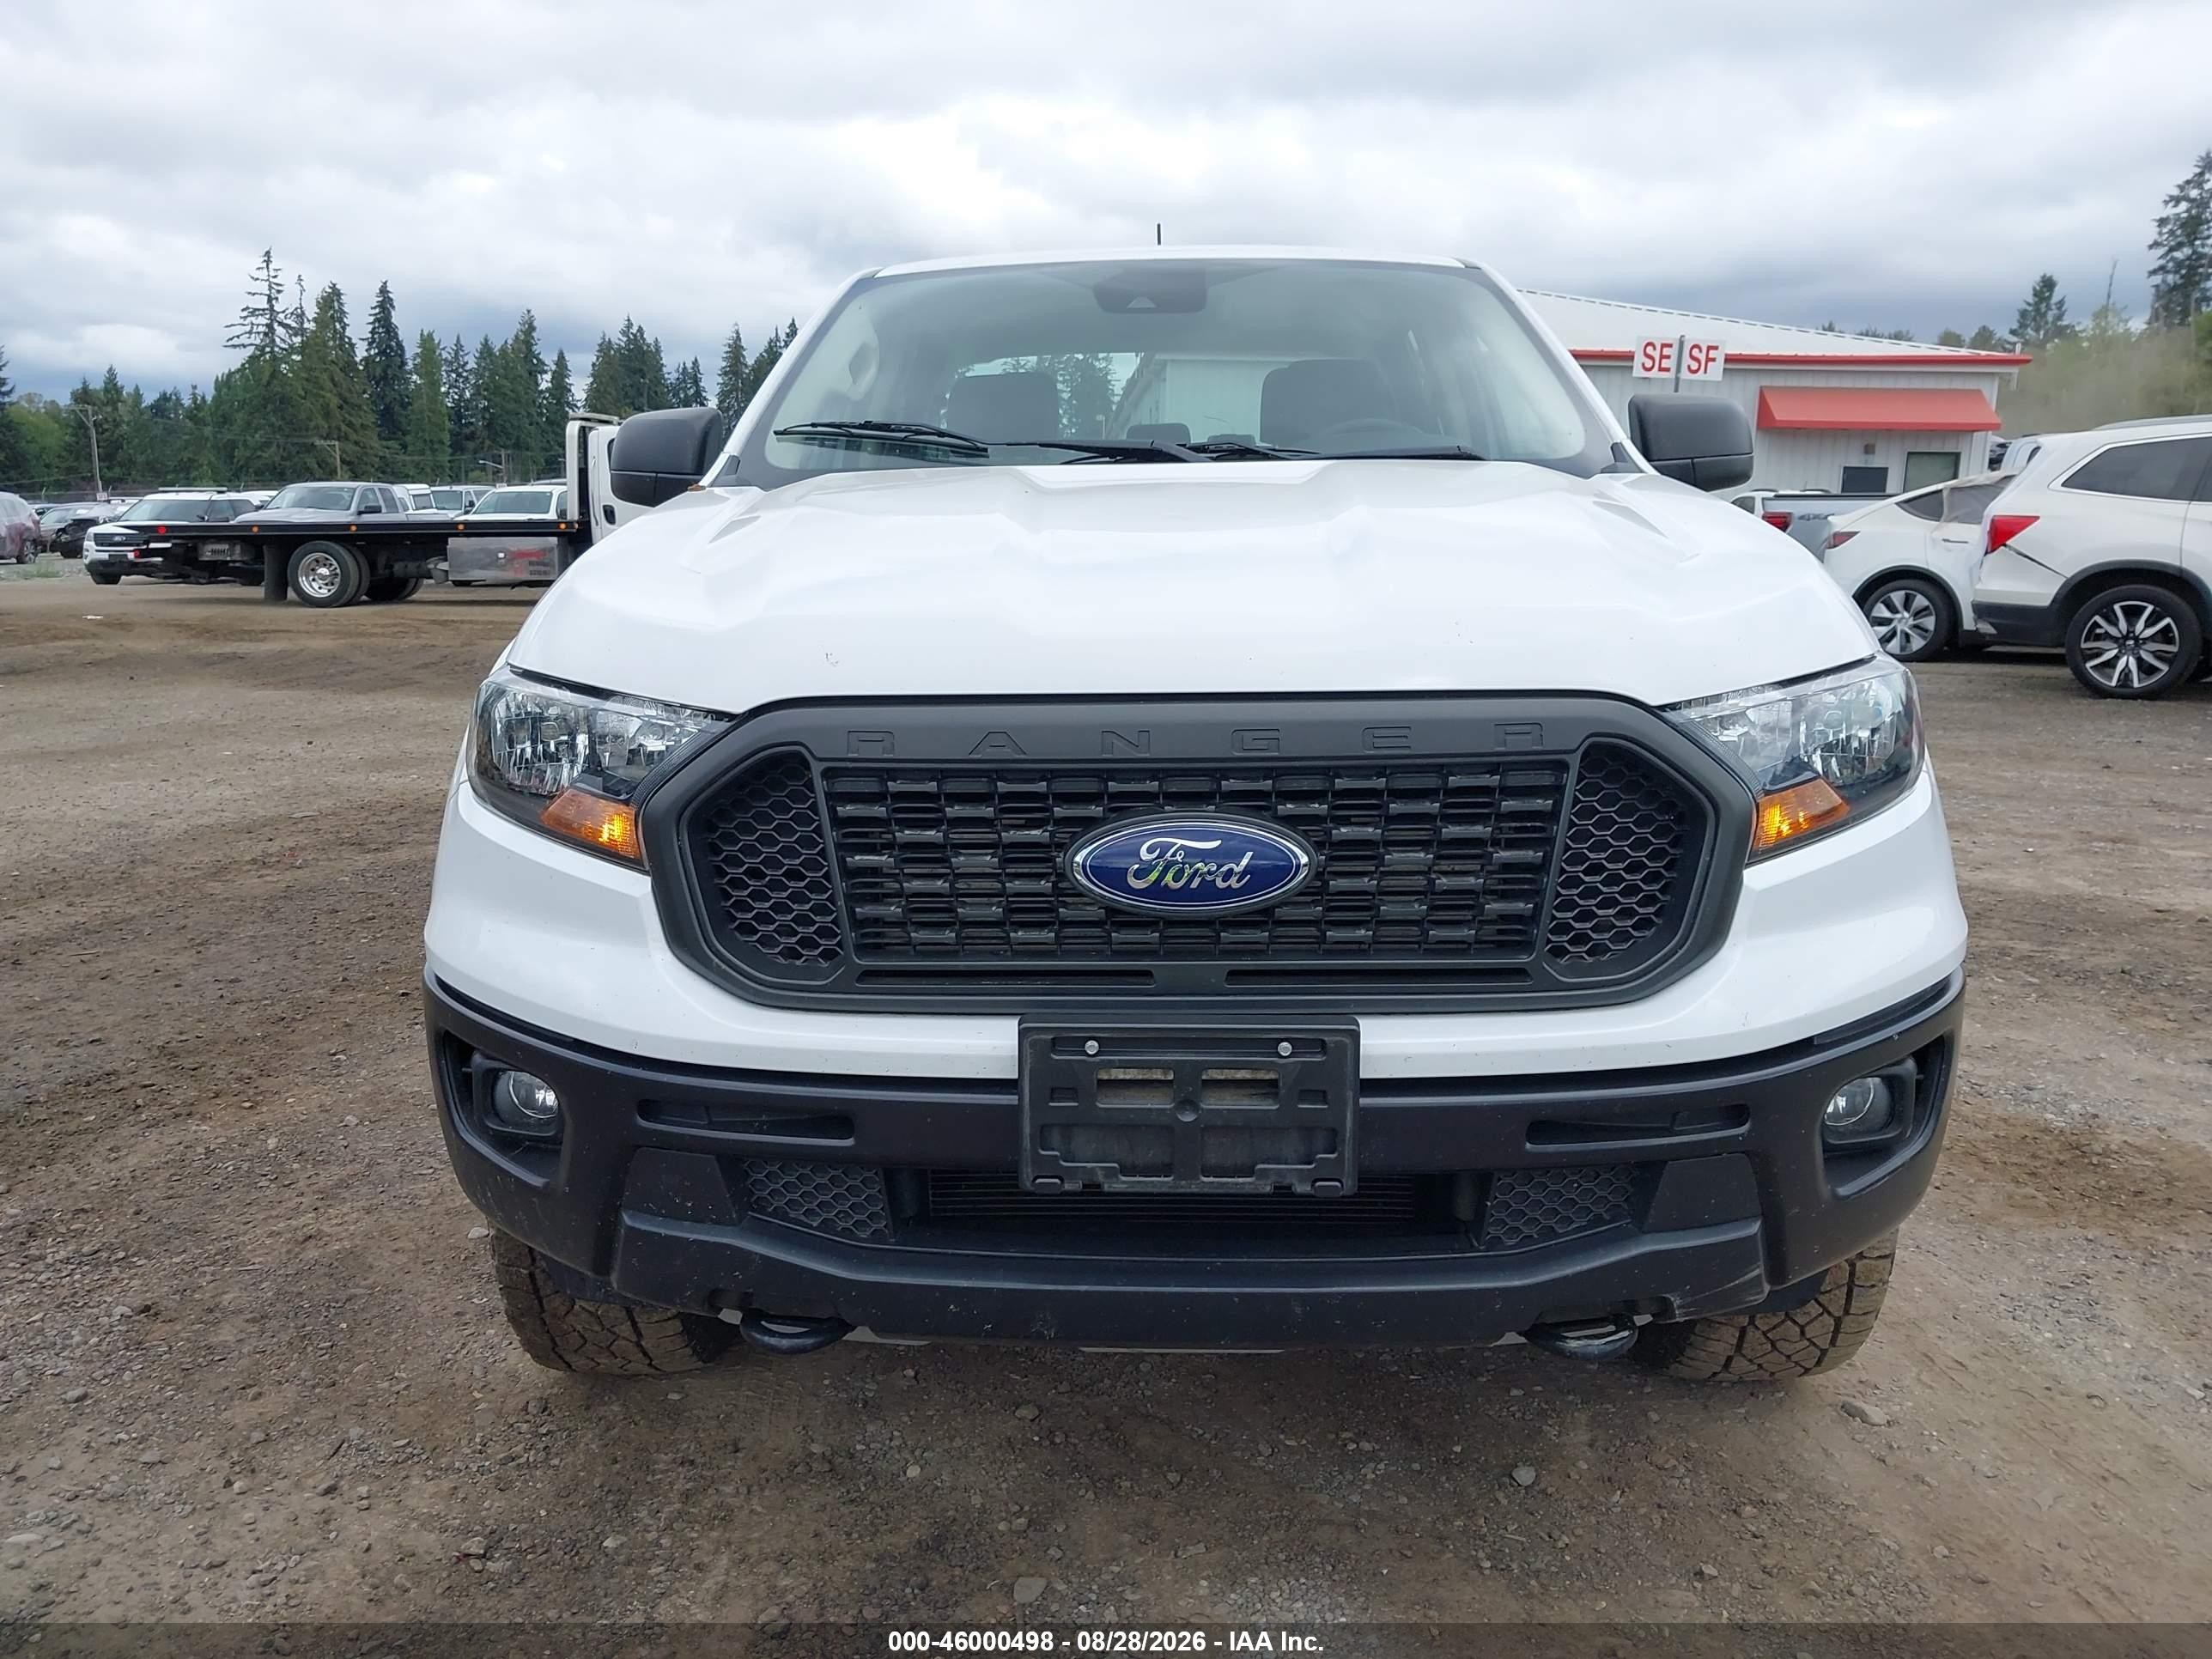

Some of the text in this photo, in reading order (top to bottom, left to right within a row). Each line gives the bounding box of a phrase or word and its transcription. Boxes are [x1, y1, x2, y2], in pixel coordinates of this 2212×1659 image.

[1641, 341, 1674, 373] SE
[1686, 343, 1719, 374] SF
[847, 722, 1544, 757] RANGER
[1127, 837, 1254, 890] Ford
